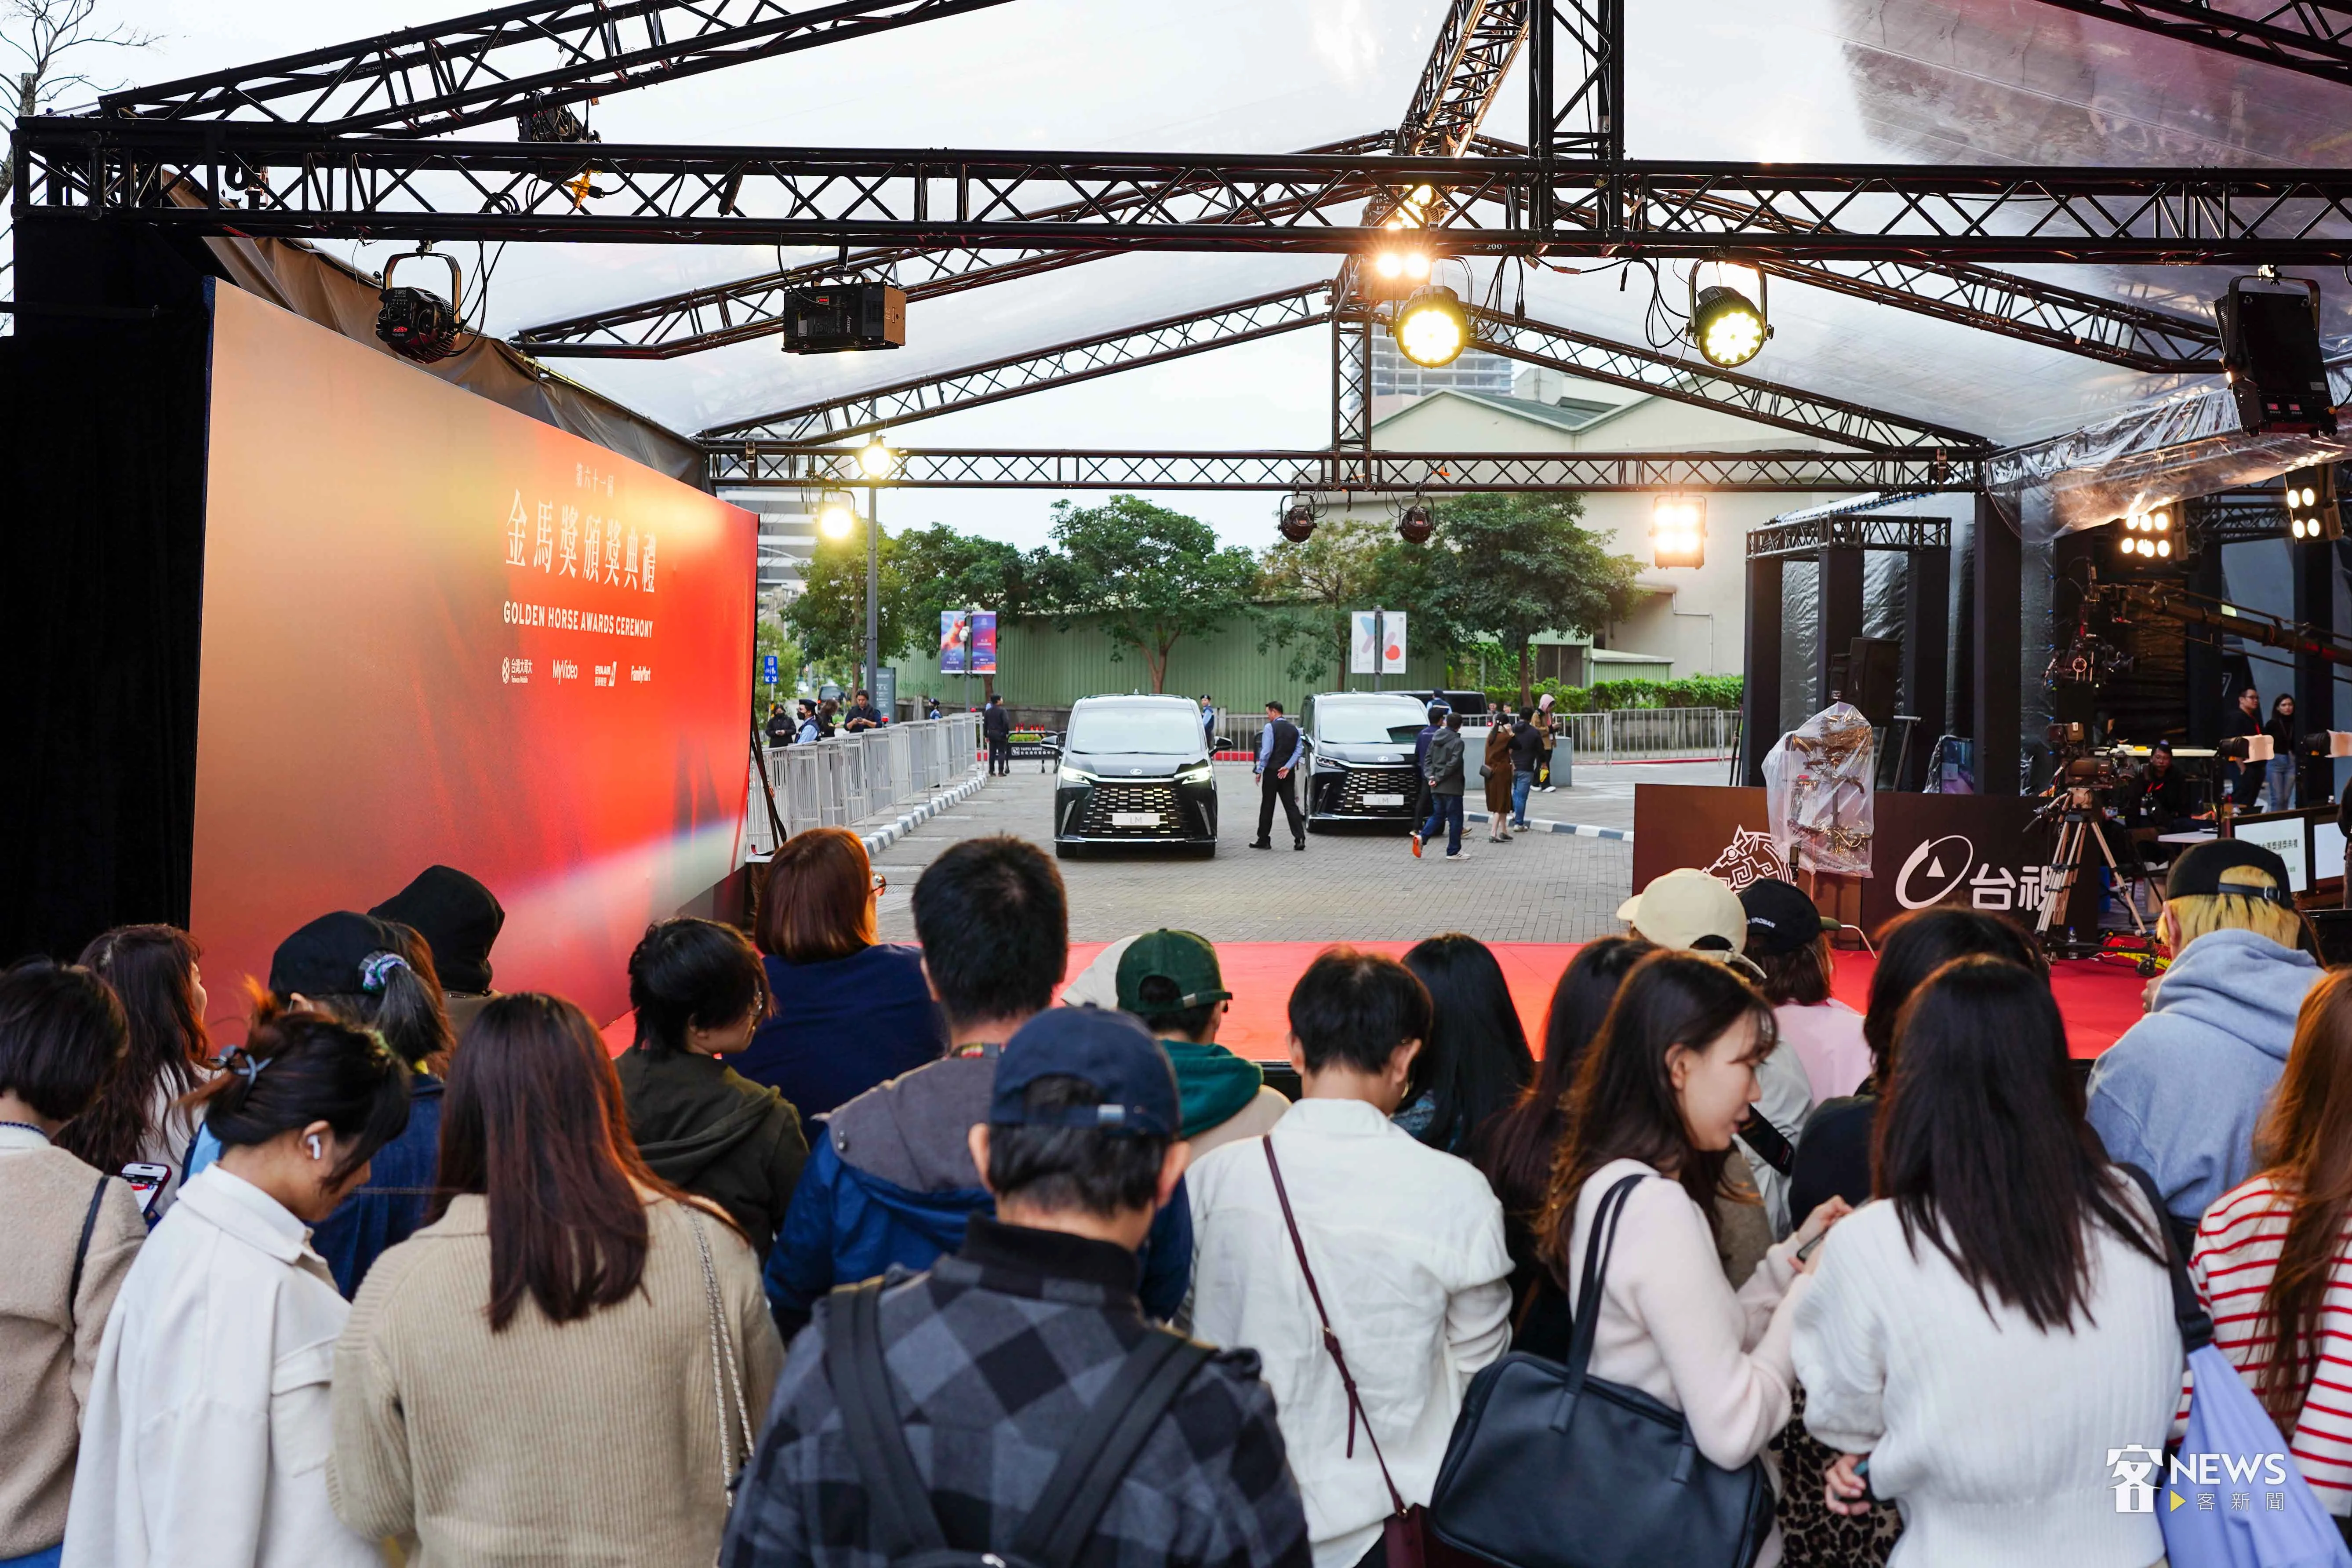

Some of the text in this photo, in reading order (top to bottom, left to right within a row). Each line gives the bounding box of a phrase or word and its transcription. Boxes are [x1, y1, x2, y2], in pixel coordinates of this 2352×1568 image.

[505, 488, 657, 593] 金馬獎頒獎典禮
[503, 600, 654, 638] GOLDEN HORSE AWARDS CEREMONY
[552, 659, 578, 685] MyVideo
